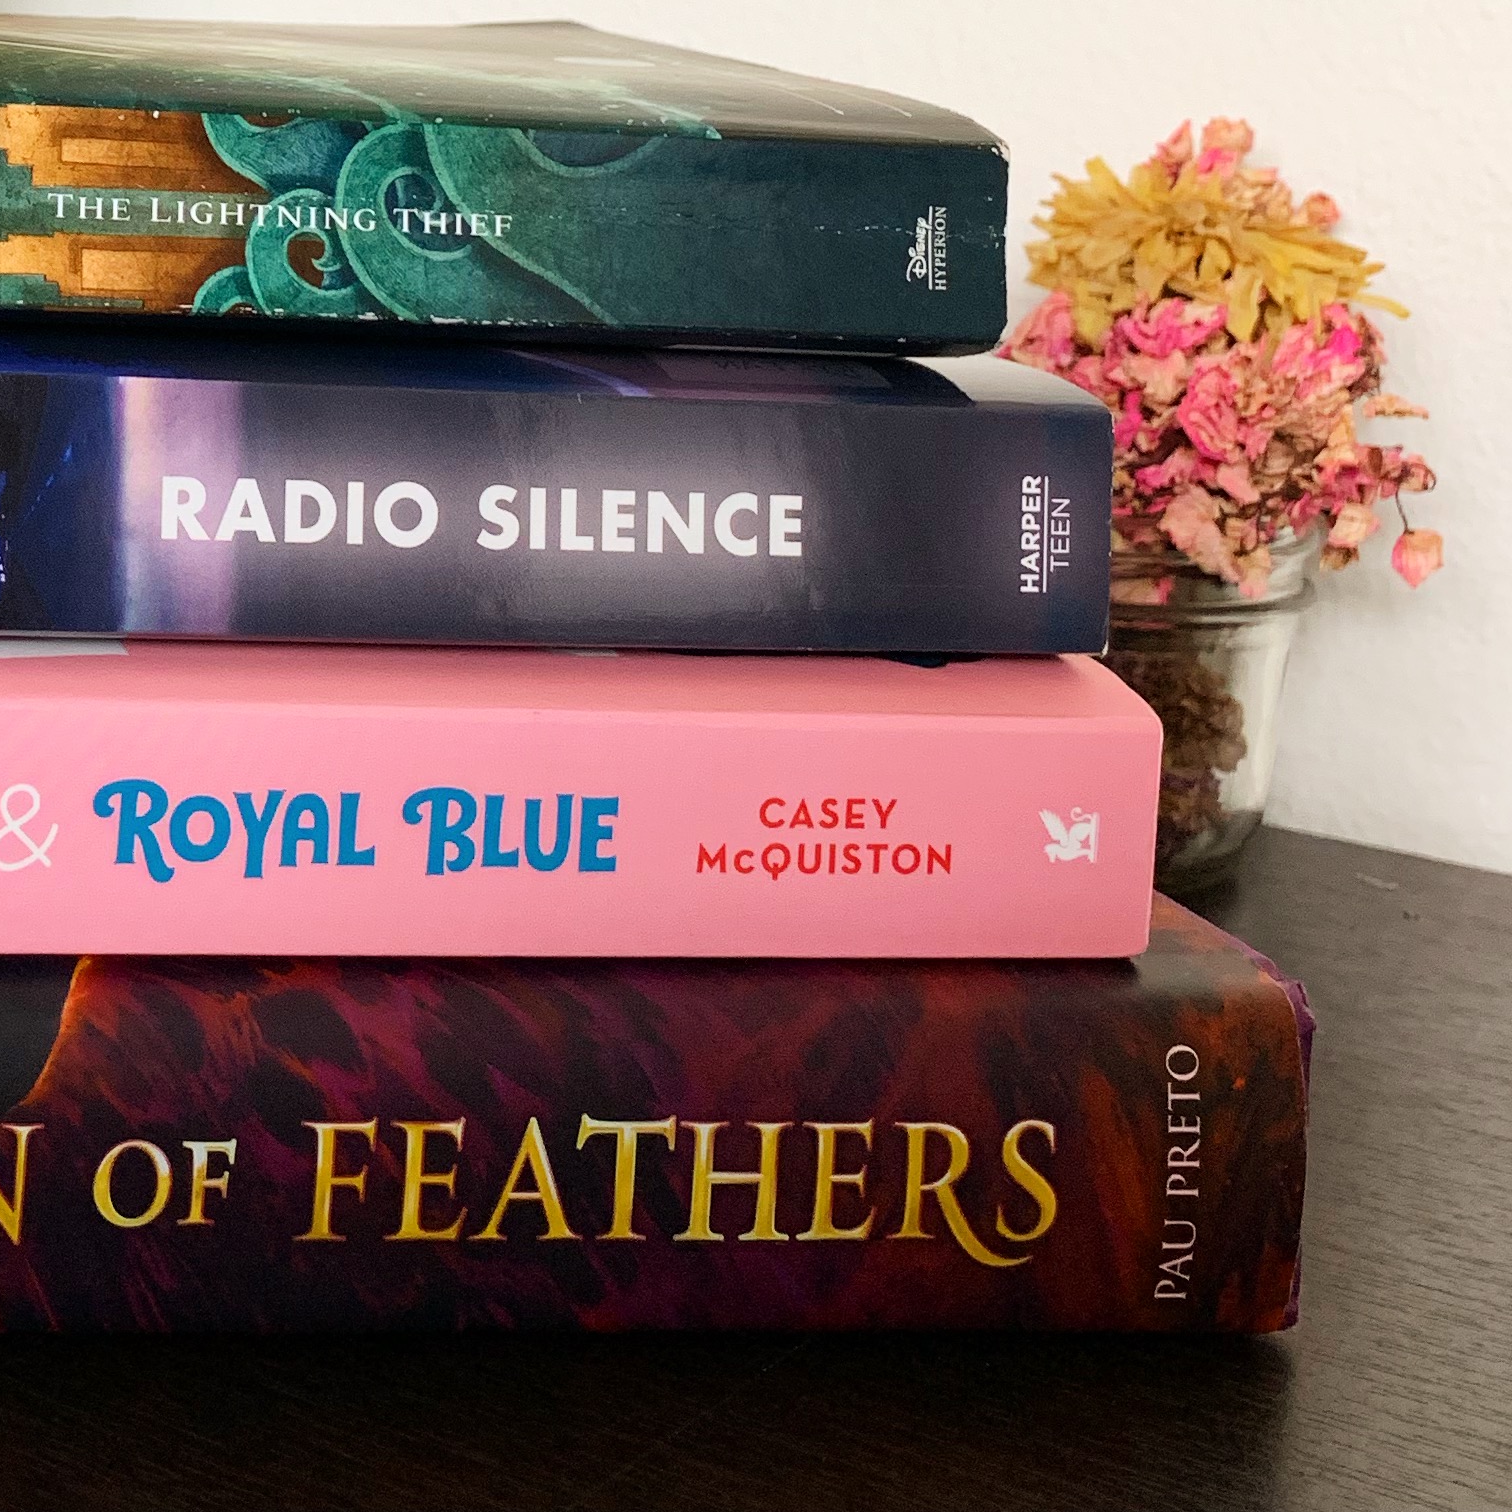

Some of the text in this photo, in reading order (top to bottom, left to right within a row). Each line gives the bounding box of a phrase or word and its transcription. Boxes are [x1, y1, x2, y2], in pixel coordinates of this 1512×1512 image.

[47, 192, 514, 238] THE LIGHTNING THIEF
[934, 206, 948, 291] HYPERION
[160, 475, 803, 557] RADIO SILENCE
[1019, 475, 1042, 593] HARPER
[1050, 498, 1070, 573] TEEN
[92, 778, 376, 884] ROYAL
[401, 785, 620, 877] BLUE
[758, 797, 898, 830] CASEY
[695, 842, 953, 881] McQUISTON
[91, 1138, 238, 1229] OF
[292, 1113, 1058, 1268] FEATHERS
[1153, 1044, 1201, 1300] PAU PRETO
